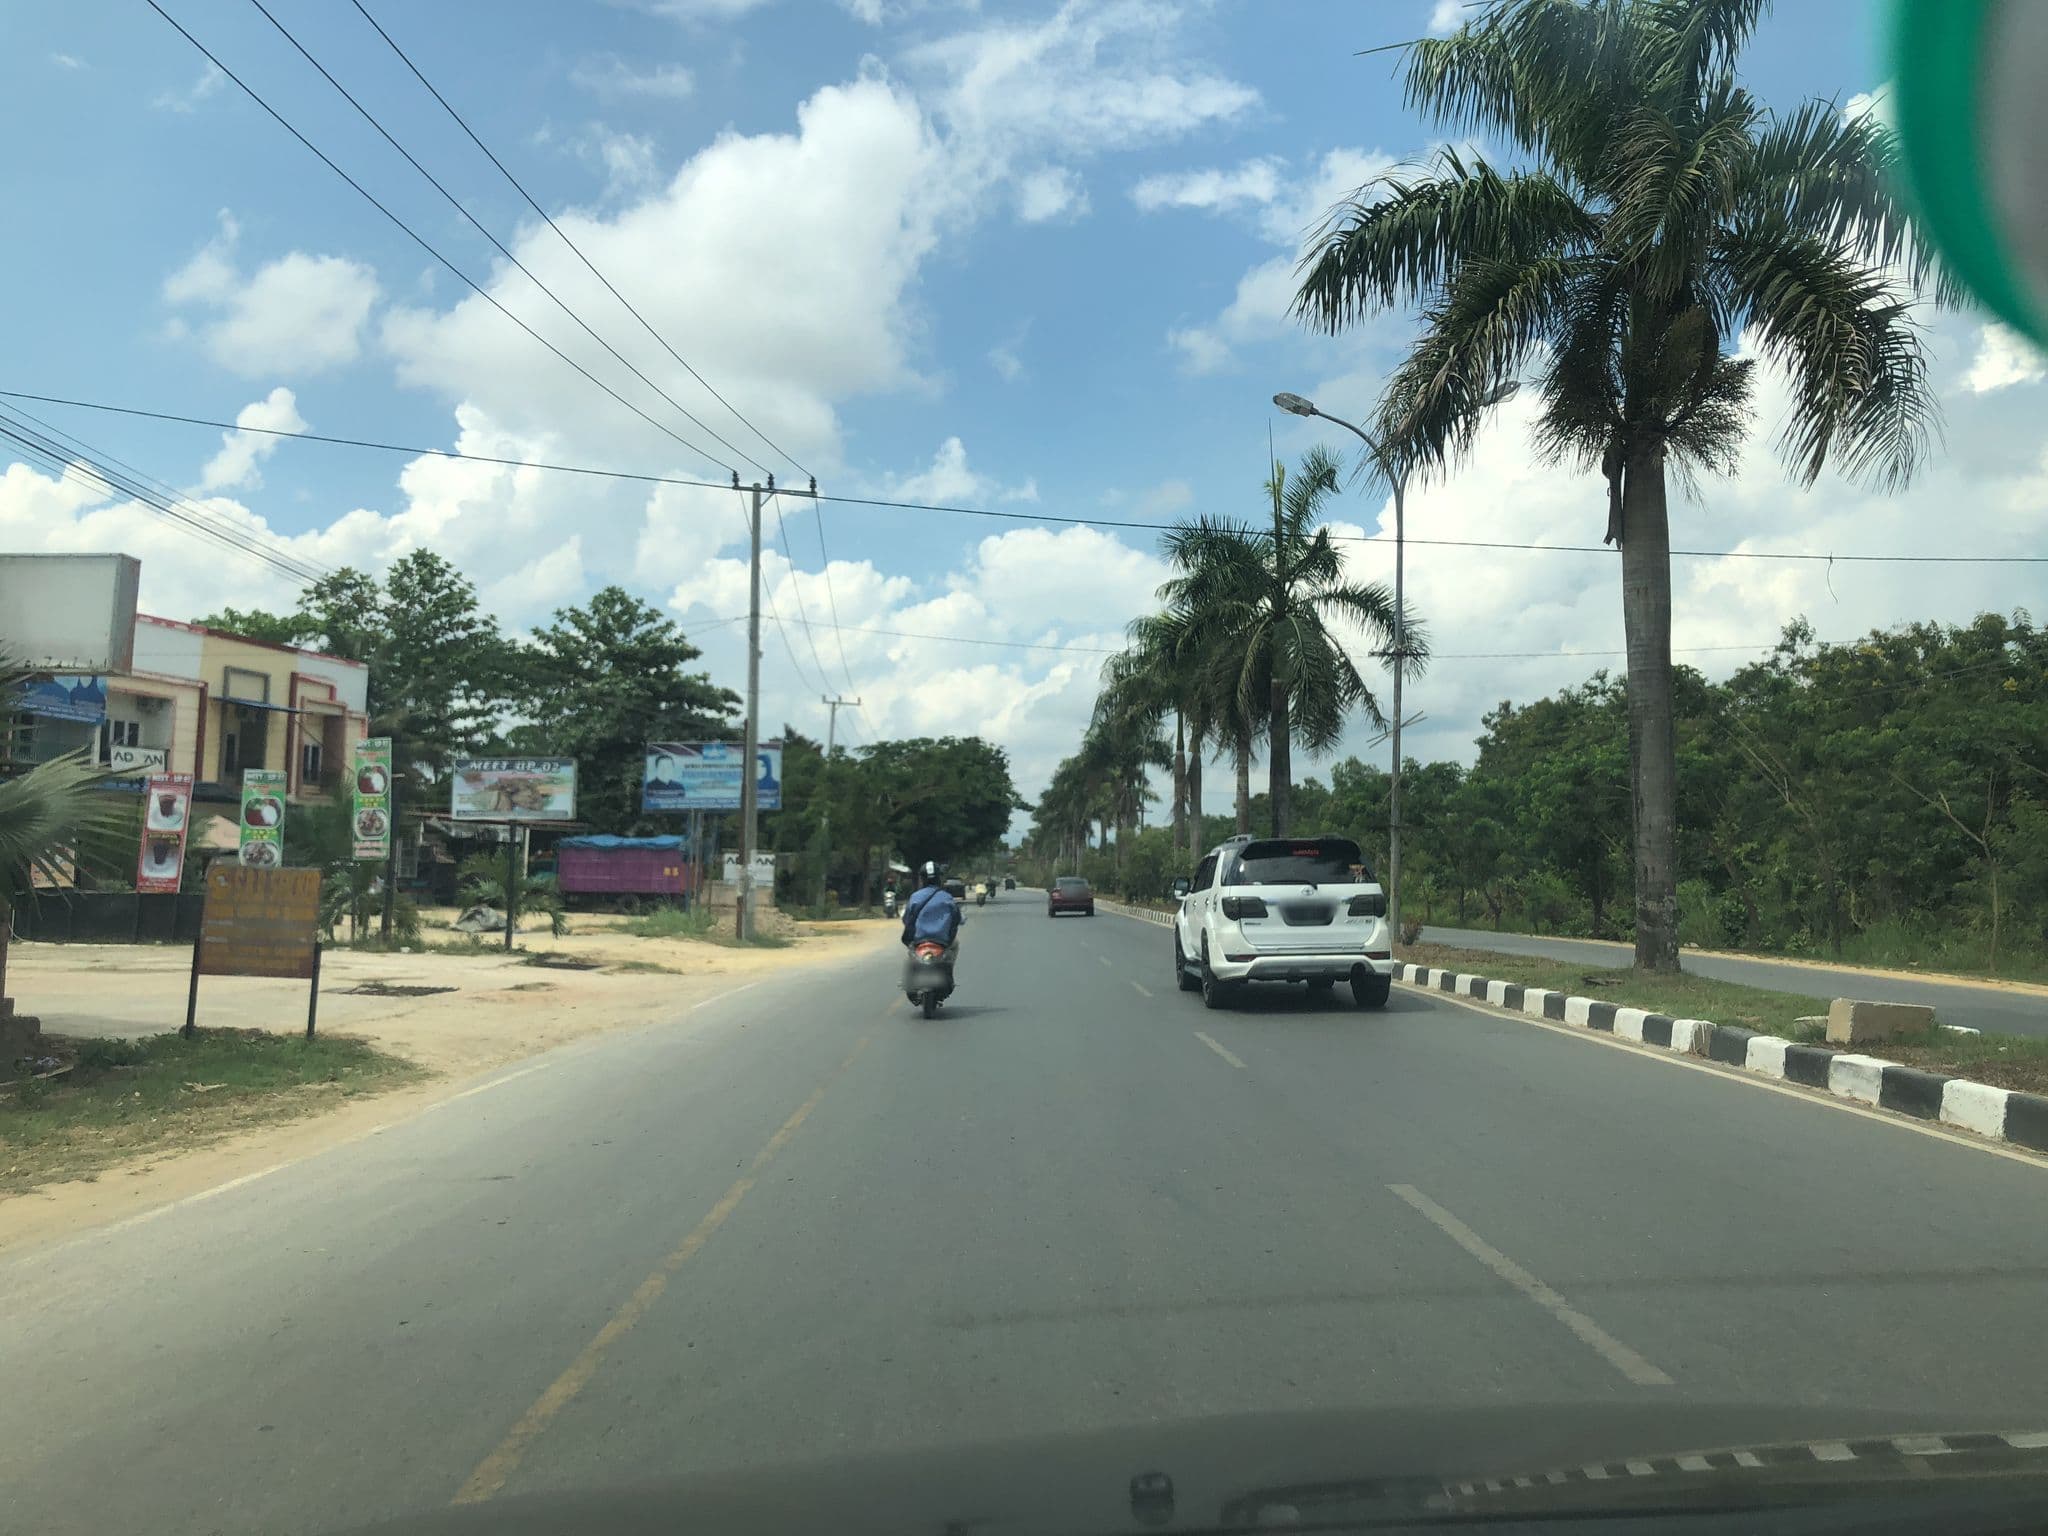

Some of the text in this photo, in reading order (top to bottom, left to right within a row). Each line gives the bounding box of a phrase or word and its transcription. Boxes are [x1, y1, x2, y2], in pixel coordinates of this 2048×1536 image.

[469, 760, 560, 773] MEET UP 02
